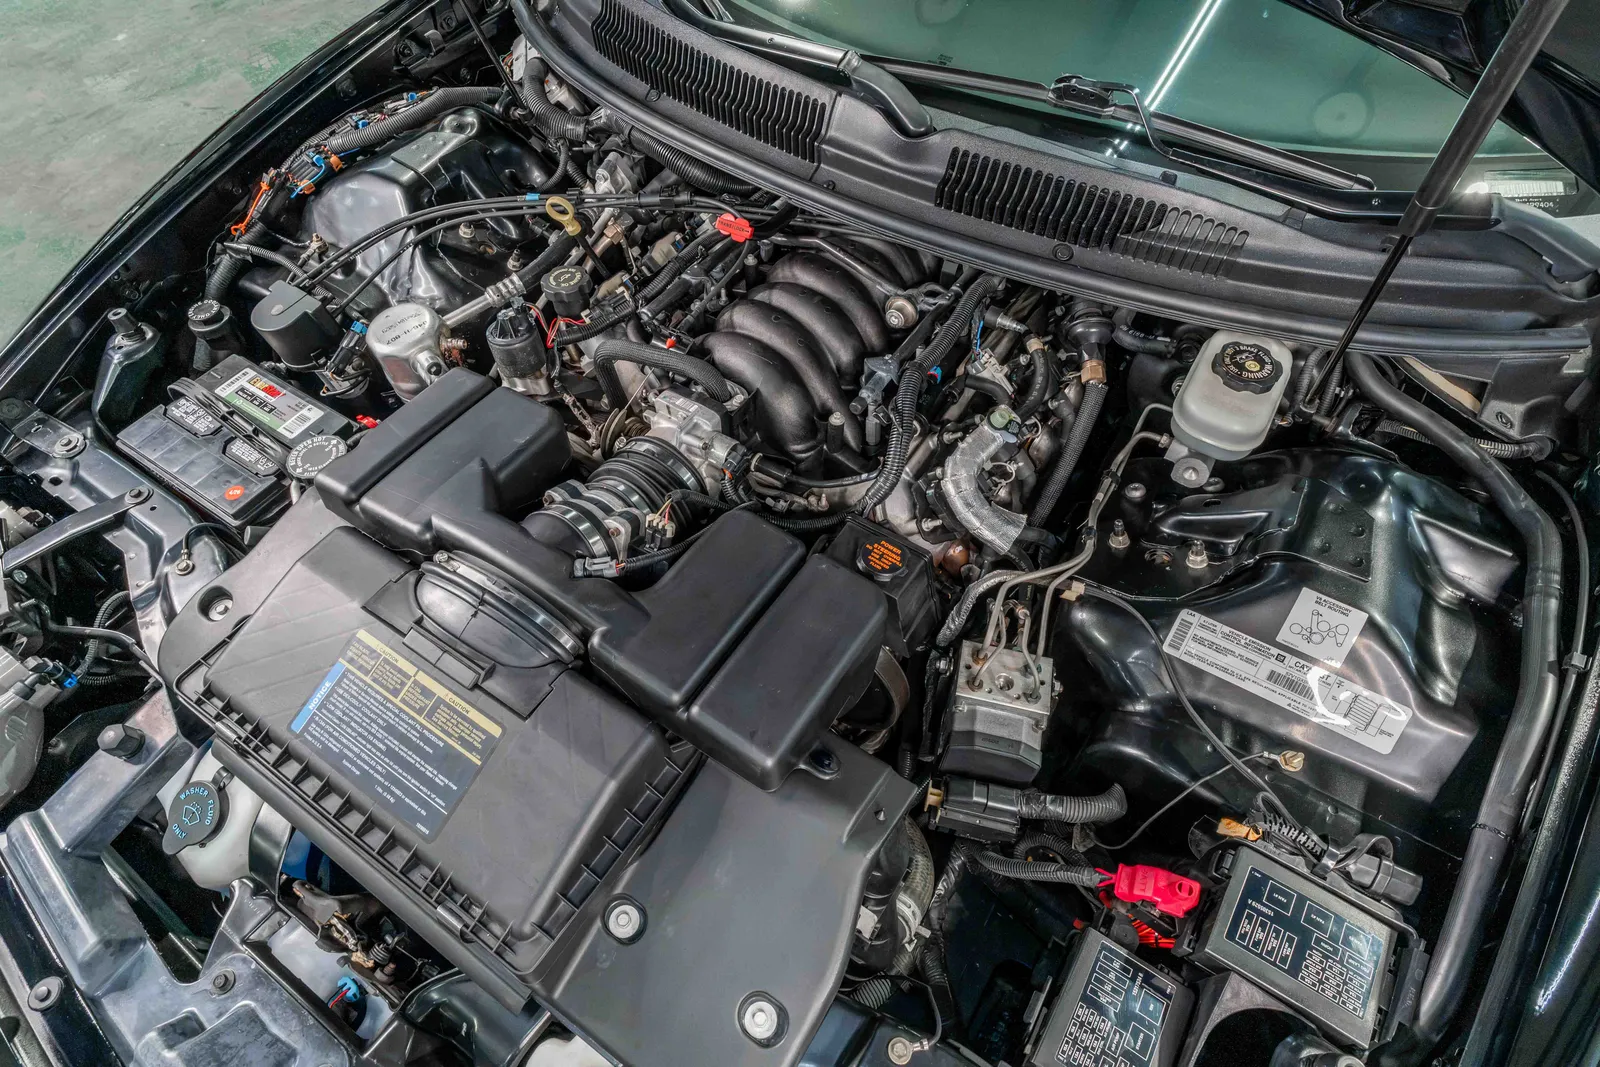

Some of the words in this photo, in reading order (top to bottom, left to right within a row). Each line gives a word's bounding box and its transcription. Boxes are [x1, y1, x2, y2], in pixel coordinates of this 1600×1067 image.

[1258, 351, 1272, 363] FLUID
[1242, 364, 1272, 378] WARNING
[298, 439, 312, 450] OPEN
[873, 543, 900, 560] STEERING
[880, 540, 901, 553] POWER
[1314, 599, 1327, 607] BELT
[1327, 604, 1349, 617] ROUTING
[1322, 598, 1351, 613] ACCESSORY
[1220, 630, 1242, 642] CONTROL
[1243, 640, 1275, 658] INFORMATION
[1228, 629, 1248, 641] VEHICLE
[1248, 638, 1271, 652] EMISSION
[378, 647, 398, 663] CAUTION
[308, 680, 330, 710] NOTICE
[353, 678, 367, 689] VEHICLE
[366, 687, 383, 702] REQUIRES
[385, 702, 400, 714] SPECIAL
[399, 712, 416, 726] COOLANT
[422, 729, 444, 747] PROCEDURE
[448, 697, 470, 714] CAUTION
[361, 706, 377, 719] COOLANT
[376, 717, 386, 726] ONLY
[350, 721, 368, 736] INDICATOR
[338, 734, 360, 754] CONDITIONED
[359, 751, 376, 766] VEHICLES
[375, 764, 386, 774] ONLY)
[180, 787, 208, 800] WASHER
[205, 800, 215, 825] FLUID
[172, 824, 186, 839] ONLY
[1320, 941, 1332, 951] HORN
